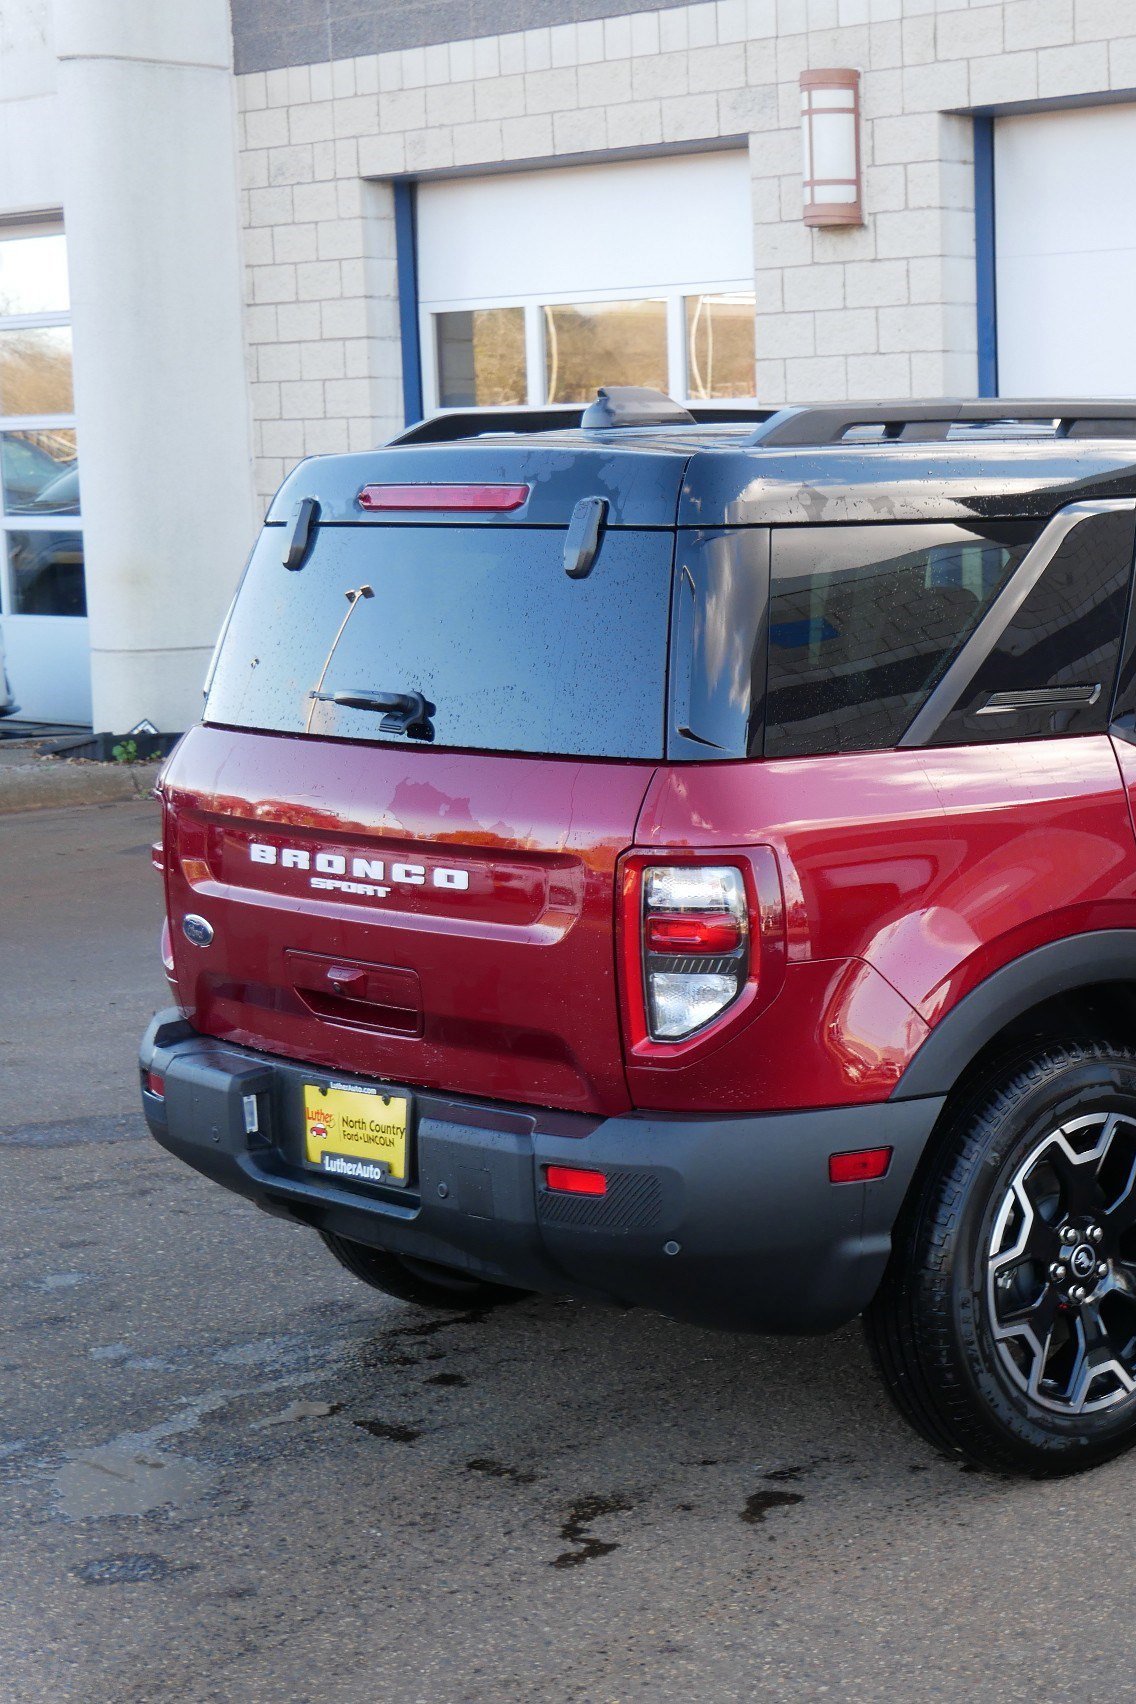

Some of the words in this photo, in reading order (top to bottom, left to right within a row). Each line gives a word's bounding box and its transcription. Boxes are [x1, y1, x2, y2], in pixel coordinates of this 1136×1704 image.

[250, 843, 469, 891] BRONCO
[310, 877, 391, 898] SPORT
[330, 1082, 377, 1095] LutherAuto.com
[305, 1107, 333, 1124] Luther
[342, 1116, 367, 1131] North
[369, 1120, 406, 1139] Country
[325, 1156, 381, 1179] LutherAuto
